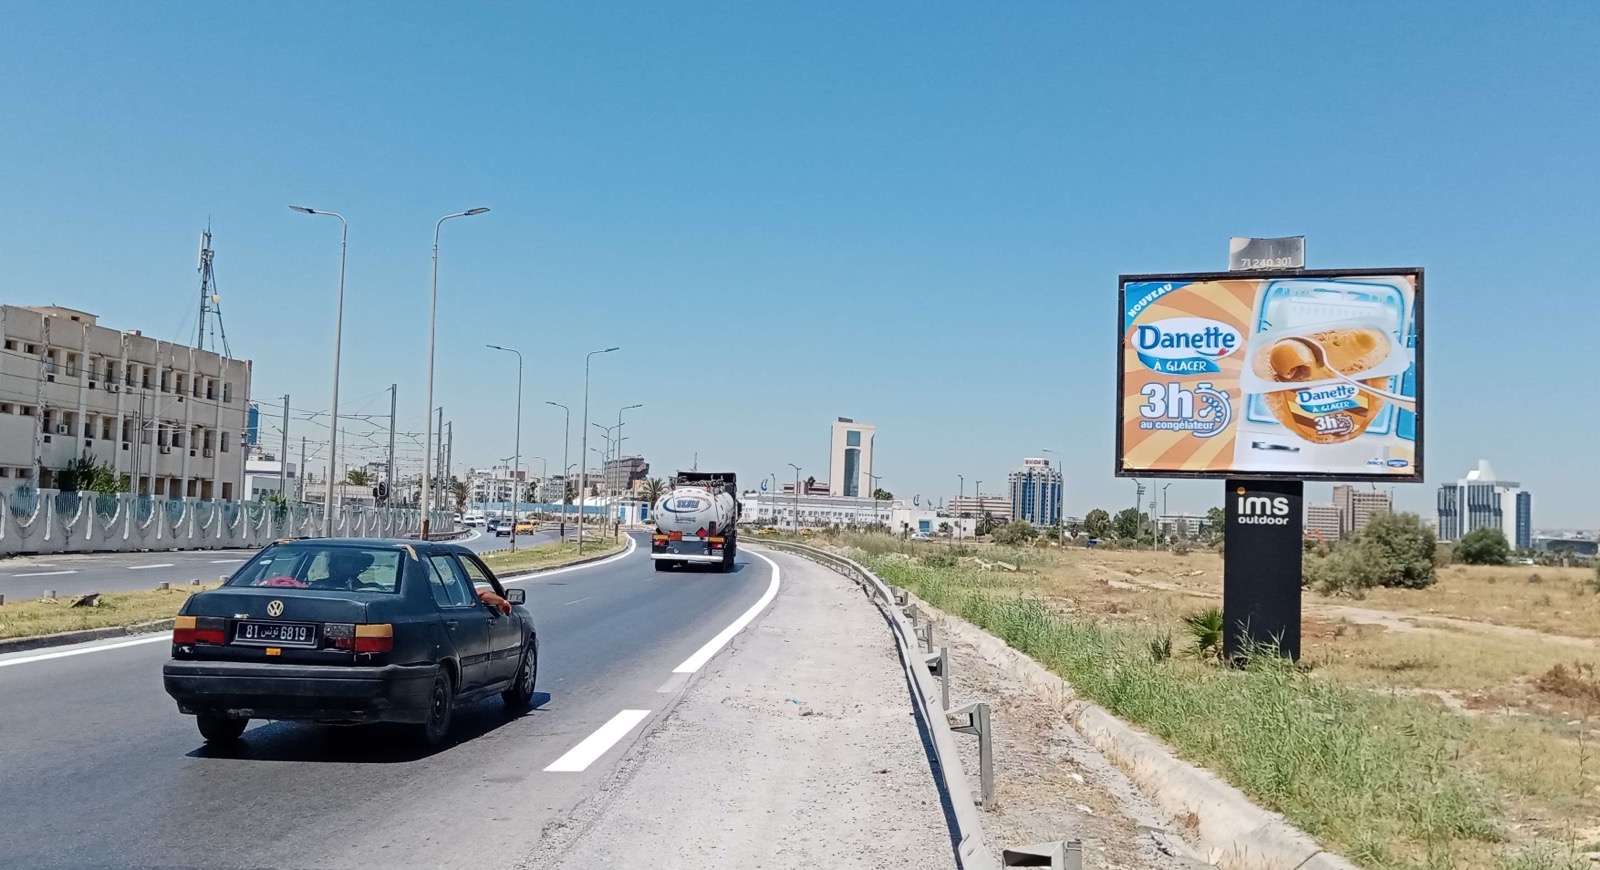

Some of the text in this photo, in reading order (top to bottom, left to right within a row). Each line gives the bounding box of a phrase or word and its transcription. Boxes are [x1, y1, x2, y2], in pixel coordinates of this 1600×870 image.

[1241, 257, 1292, 268] 71 240 301
[1127, 284, 1173, 318] NOUVEAU
[1138, 325, 1235, 350] Danette
[1153, 359, 1207, 371] À GLACER
[1139, 382, 1194, 419] 3h
[1298, 385, 1355, 403] Danette
[1320, 402, 1350, 412] GLACER
[1140, 419, 1215, 431] au congélateur
[1314, 415, 1337, 431] 3h
[1237, 486, 1290, 516] ims
[1238, 515, 1289, 525] outdoor
[246, 625, 306, 640] 81 تونس 6819
